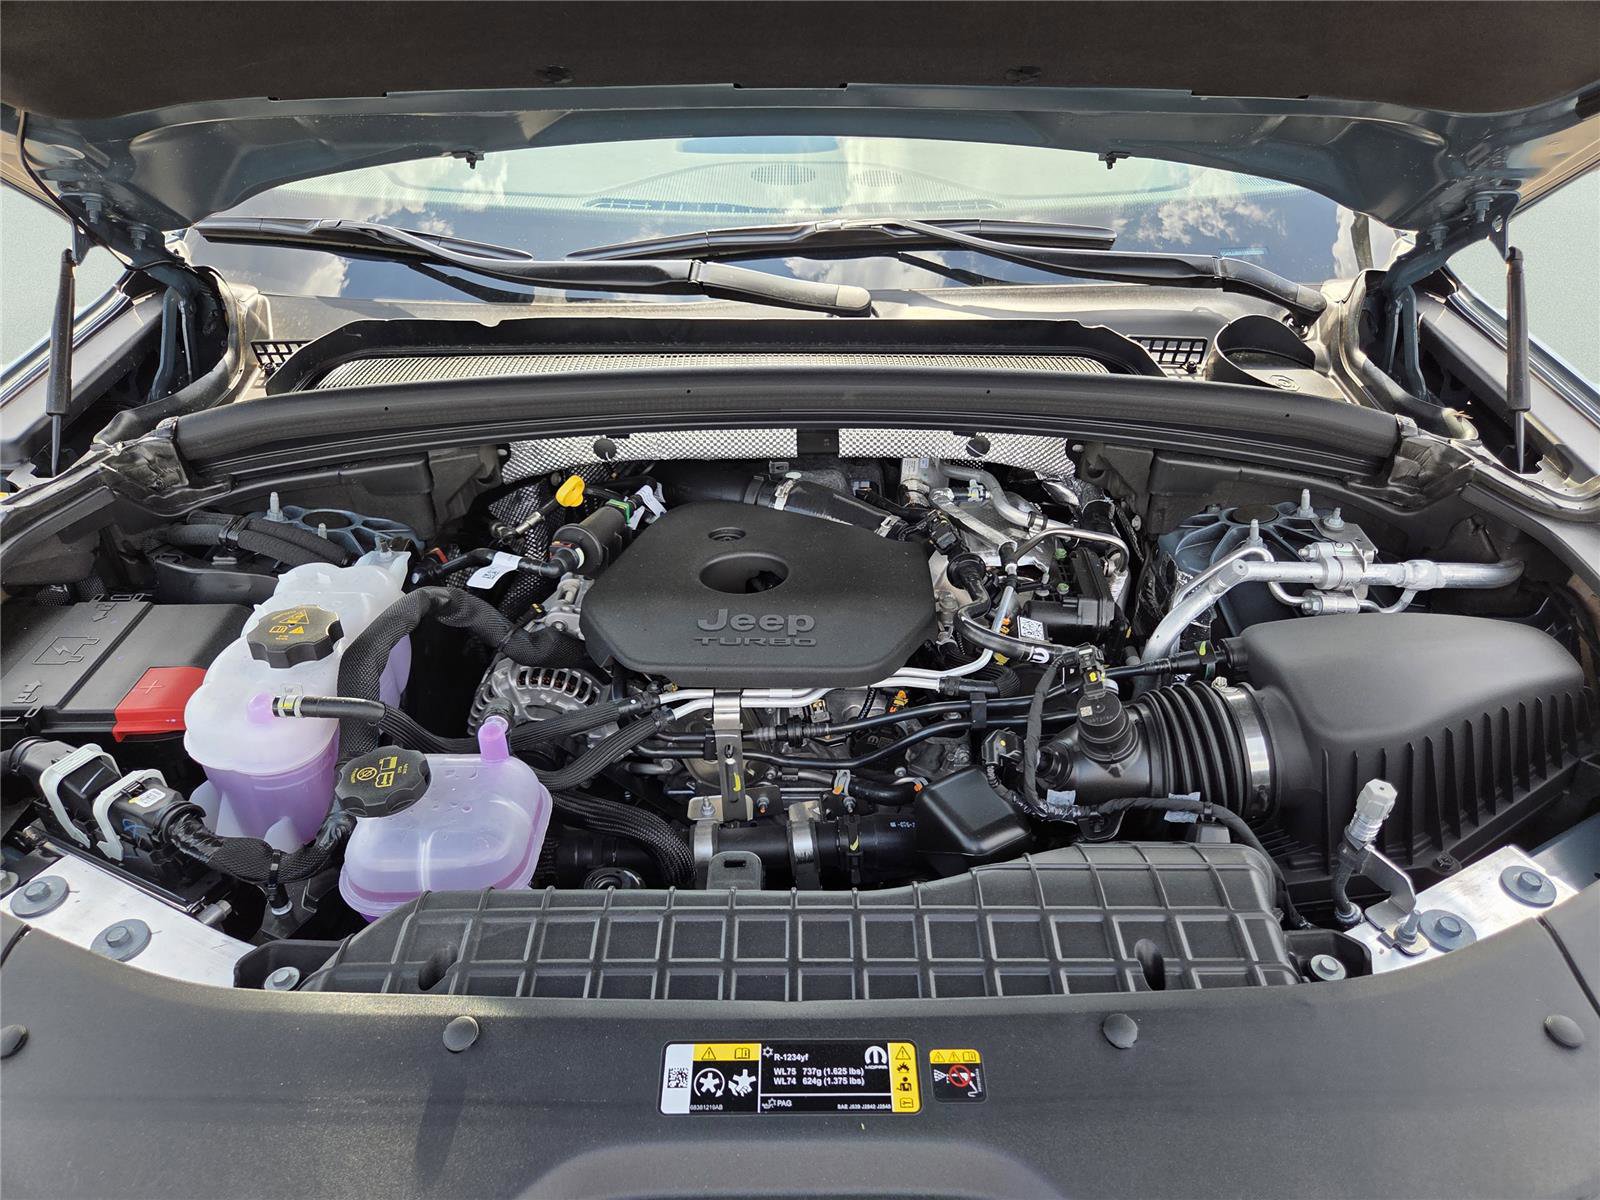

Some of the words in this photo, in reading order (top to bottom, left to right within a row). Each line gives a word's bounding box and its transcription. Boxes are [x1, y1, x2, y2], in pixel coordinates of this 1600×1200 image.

[697, 608, 816, 637] Jeep
[694, 637, 817, 647] TURBO
[773, 1053, 809, 1063] R-1234yf
[773, 1067, 797, 1076] WL75
[802, 1067, 822, 1077] 737g
[823, 1067, 848, 1077] (1.625
[848, 1067, 865, 1077] lbs)
[773, 1077, 797, 1086] WL74
[802, 1077, 822, 1087] 624g
[823, 1077, 848, 1087] (1.375
[849, 1077, 866, 1087] lbs)
[776, 1099, 793, 1107] PAG
